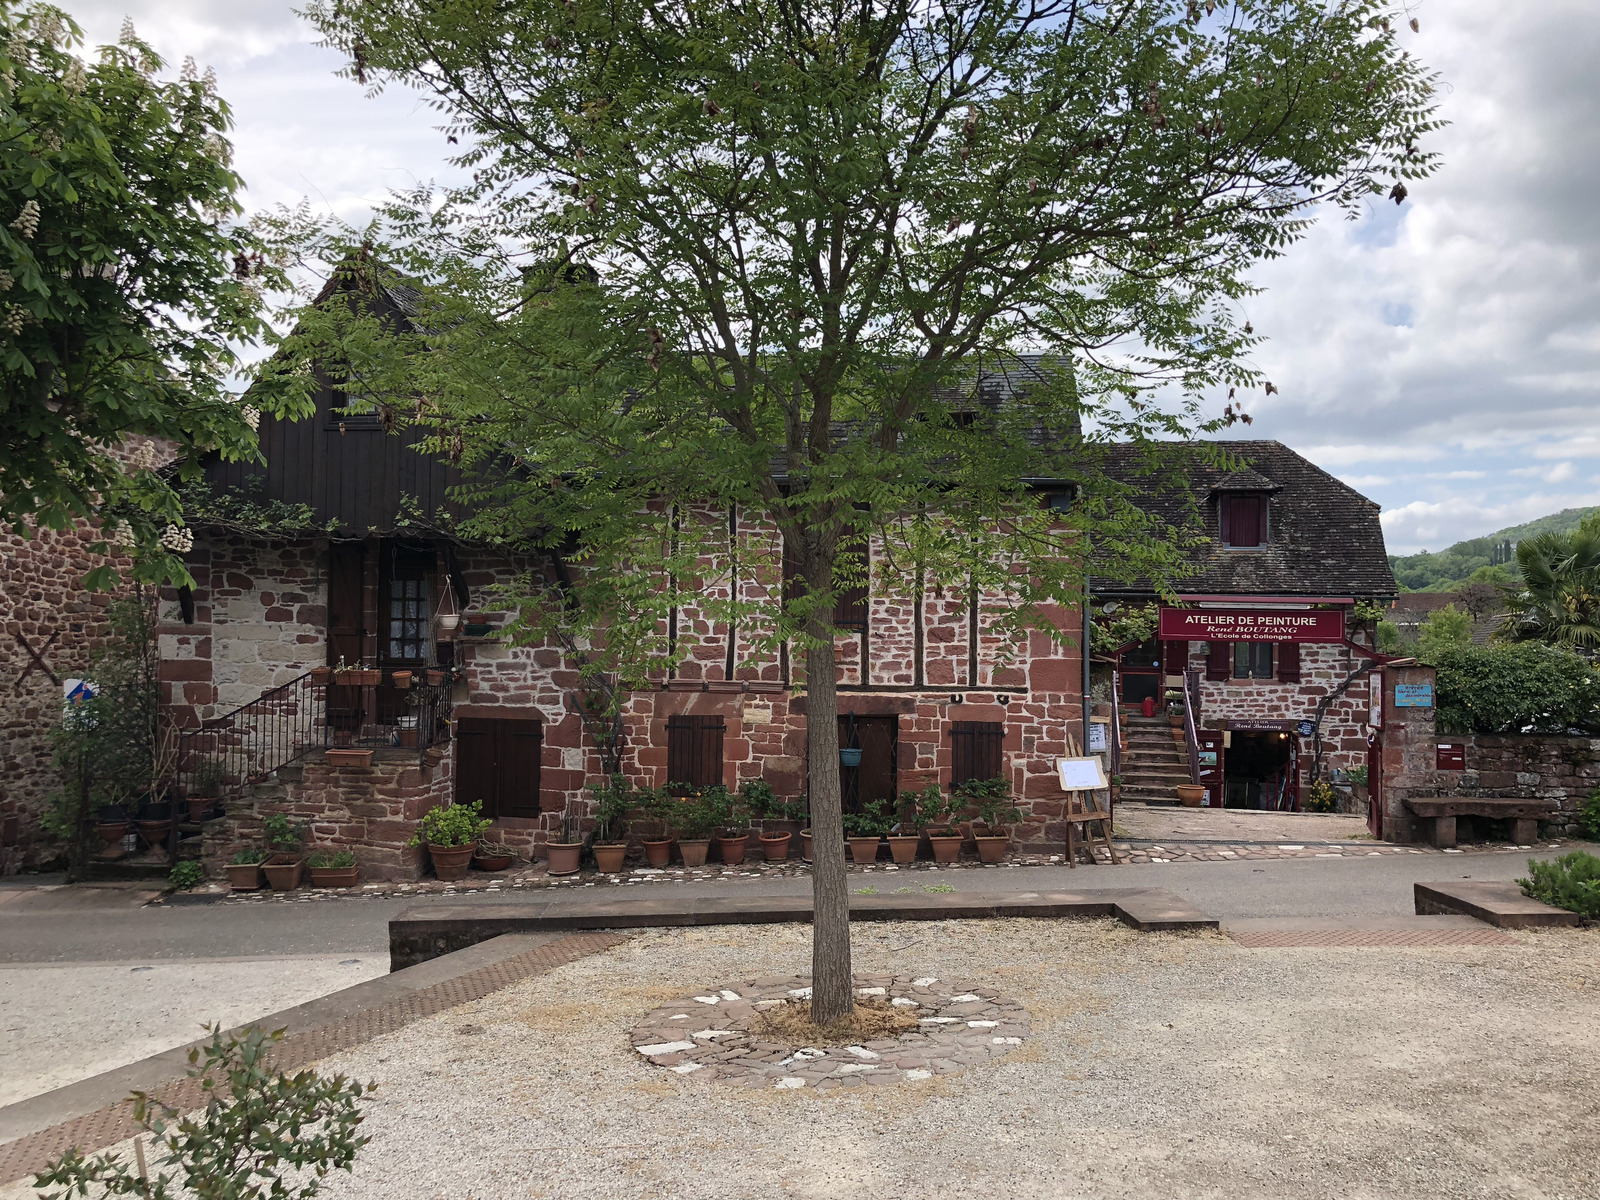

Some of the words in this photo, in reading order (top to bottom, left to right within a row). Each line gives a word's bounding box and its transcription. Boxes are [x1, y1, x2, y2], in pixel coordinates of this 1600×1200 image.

[1185, 616, 1234, 624] ATELIER
[1238, 616, 1254, 625] DE
[1258, 617, 1316, 626] PEINTURE
